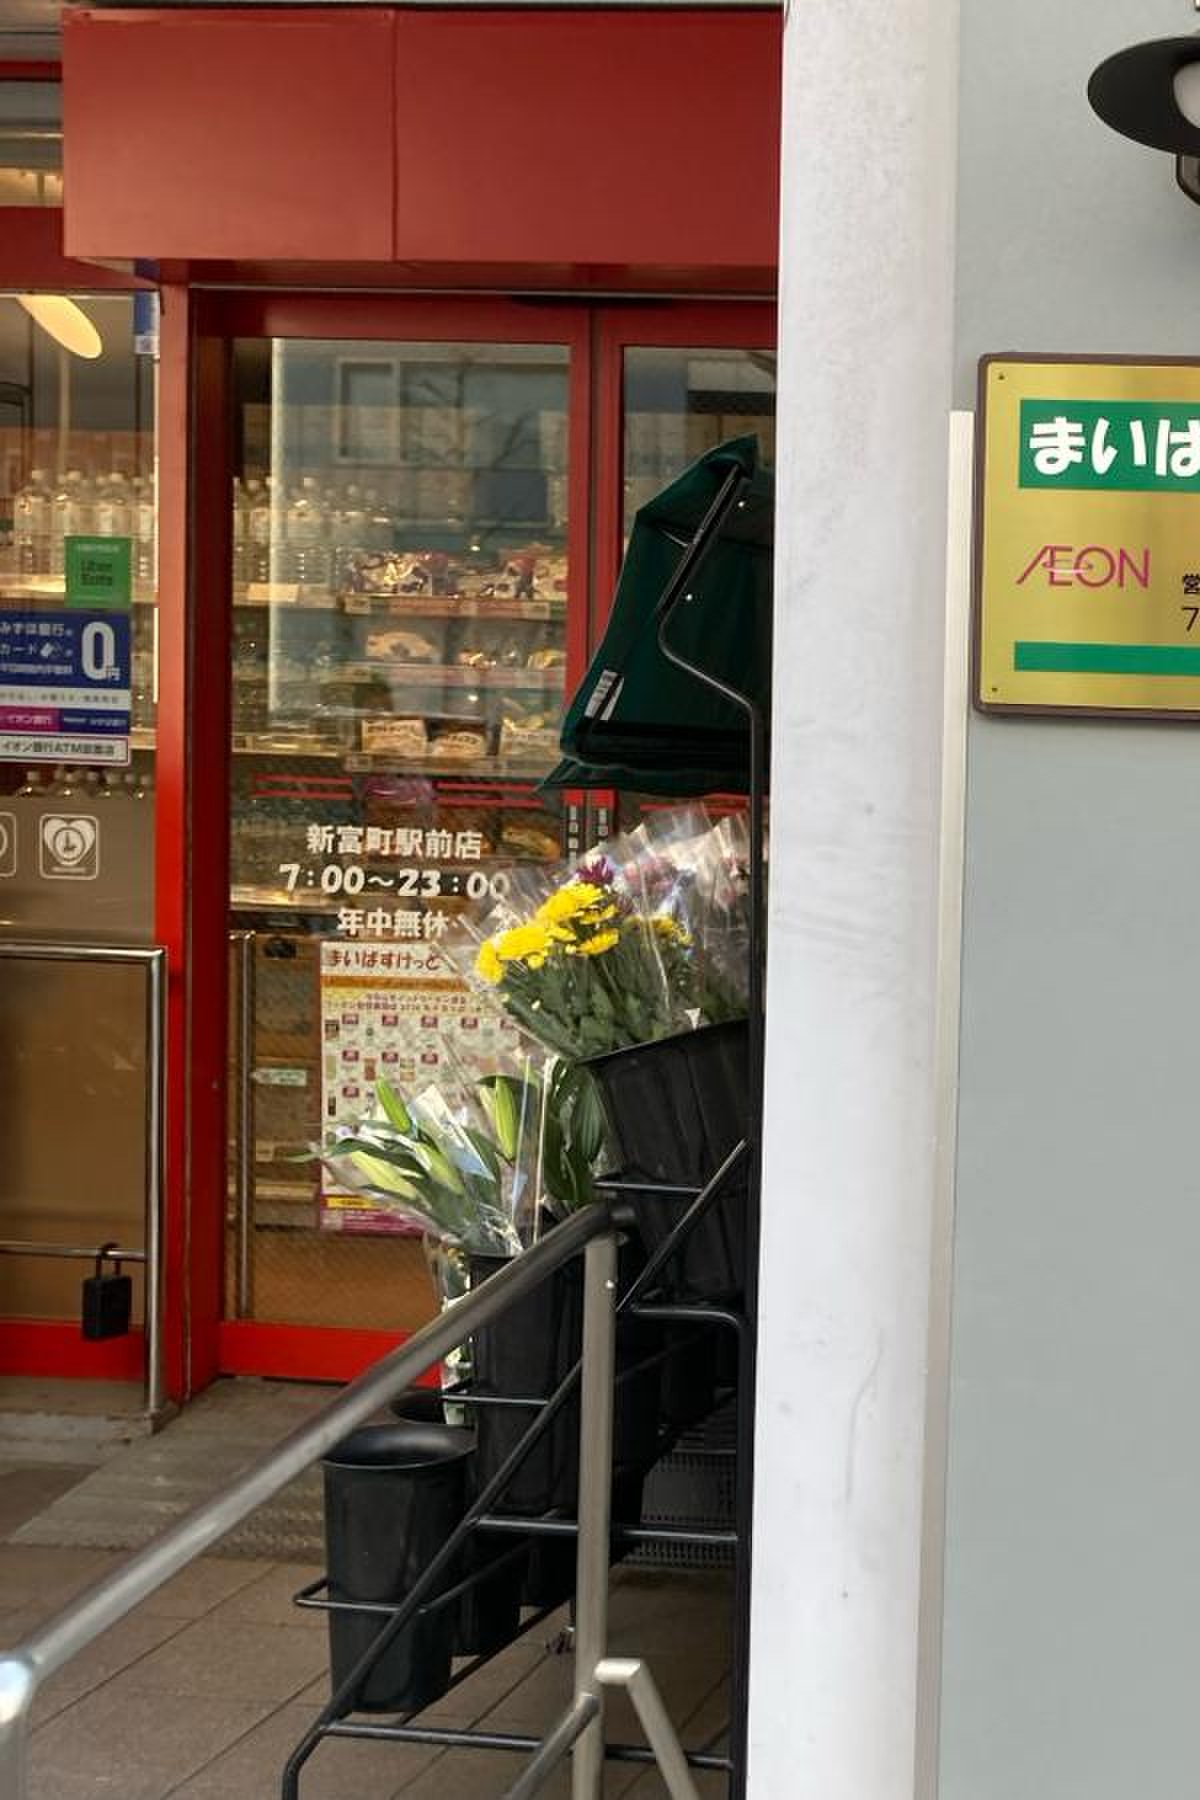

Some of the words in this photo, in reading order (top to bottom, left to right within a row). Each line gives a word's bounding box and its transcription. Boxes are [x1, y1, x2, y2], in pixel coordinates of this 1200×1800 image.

[306, 823, 483, 859] 新富町駅前店
[336, 907, 449, 938] 年中無休
